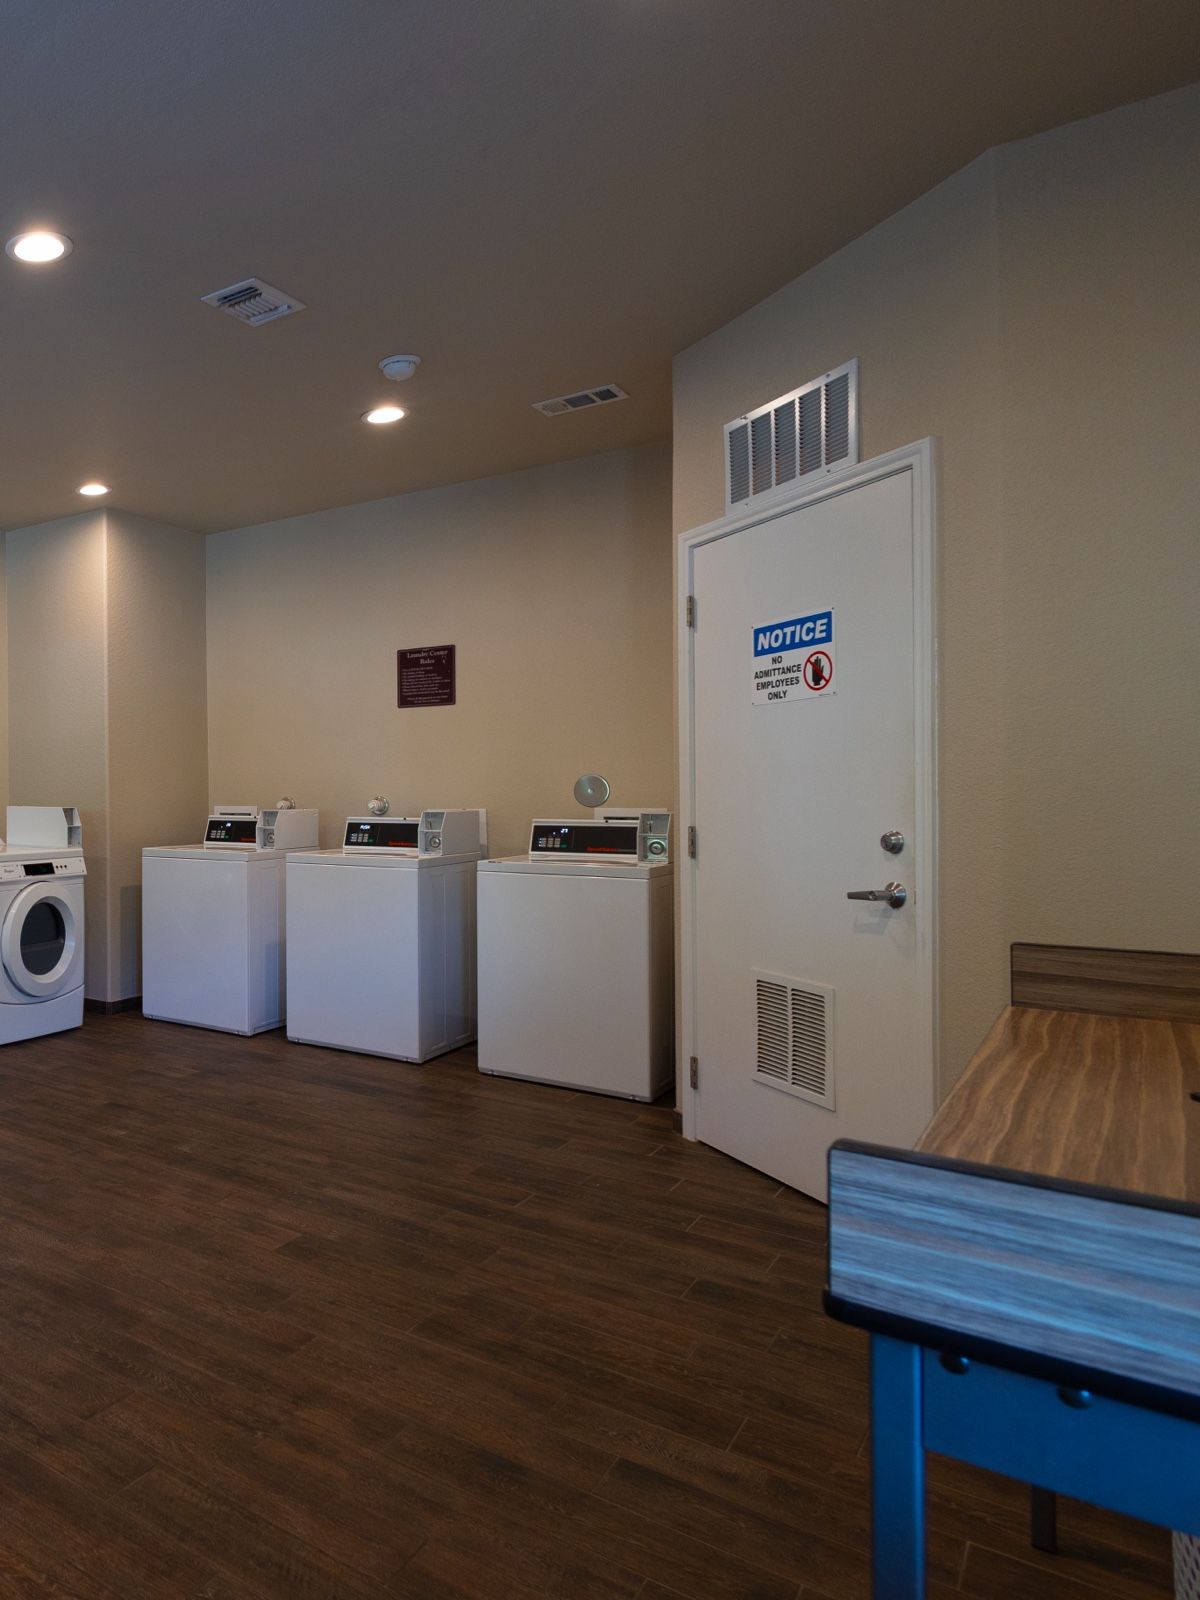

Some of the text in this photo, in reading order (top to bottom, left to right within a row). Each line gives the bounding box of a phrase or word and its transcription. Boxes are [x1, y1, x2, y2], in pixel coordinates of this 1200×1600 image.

[757, 618, 828, 651] NOTICE
[771, 655, 783, 665] NO
[754, 664, 802, 680] ADMITTANCE
[756, 676, 800, 691] EMPLOYEES
[767, 690, 788, 701] ONLY
